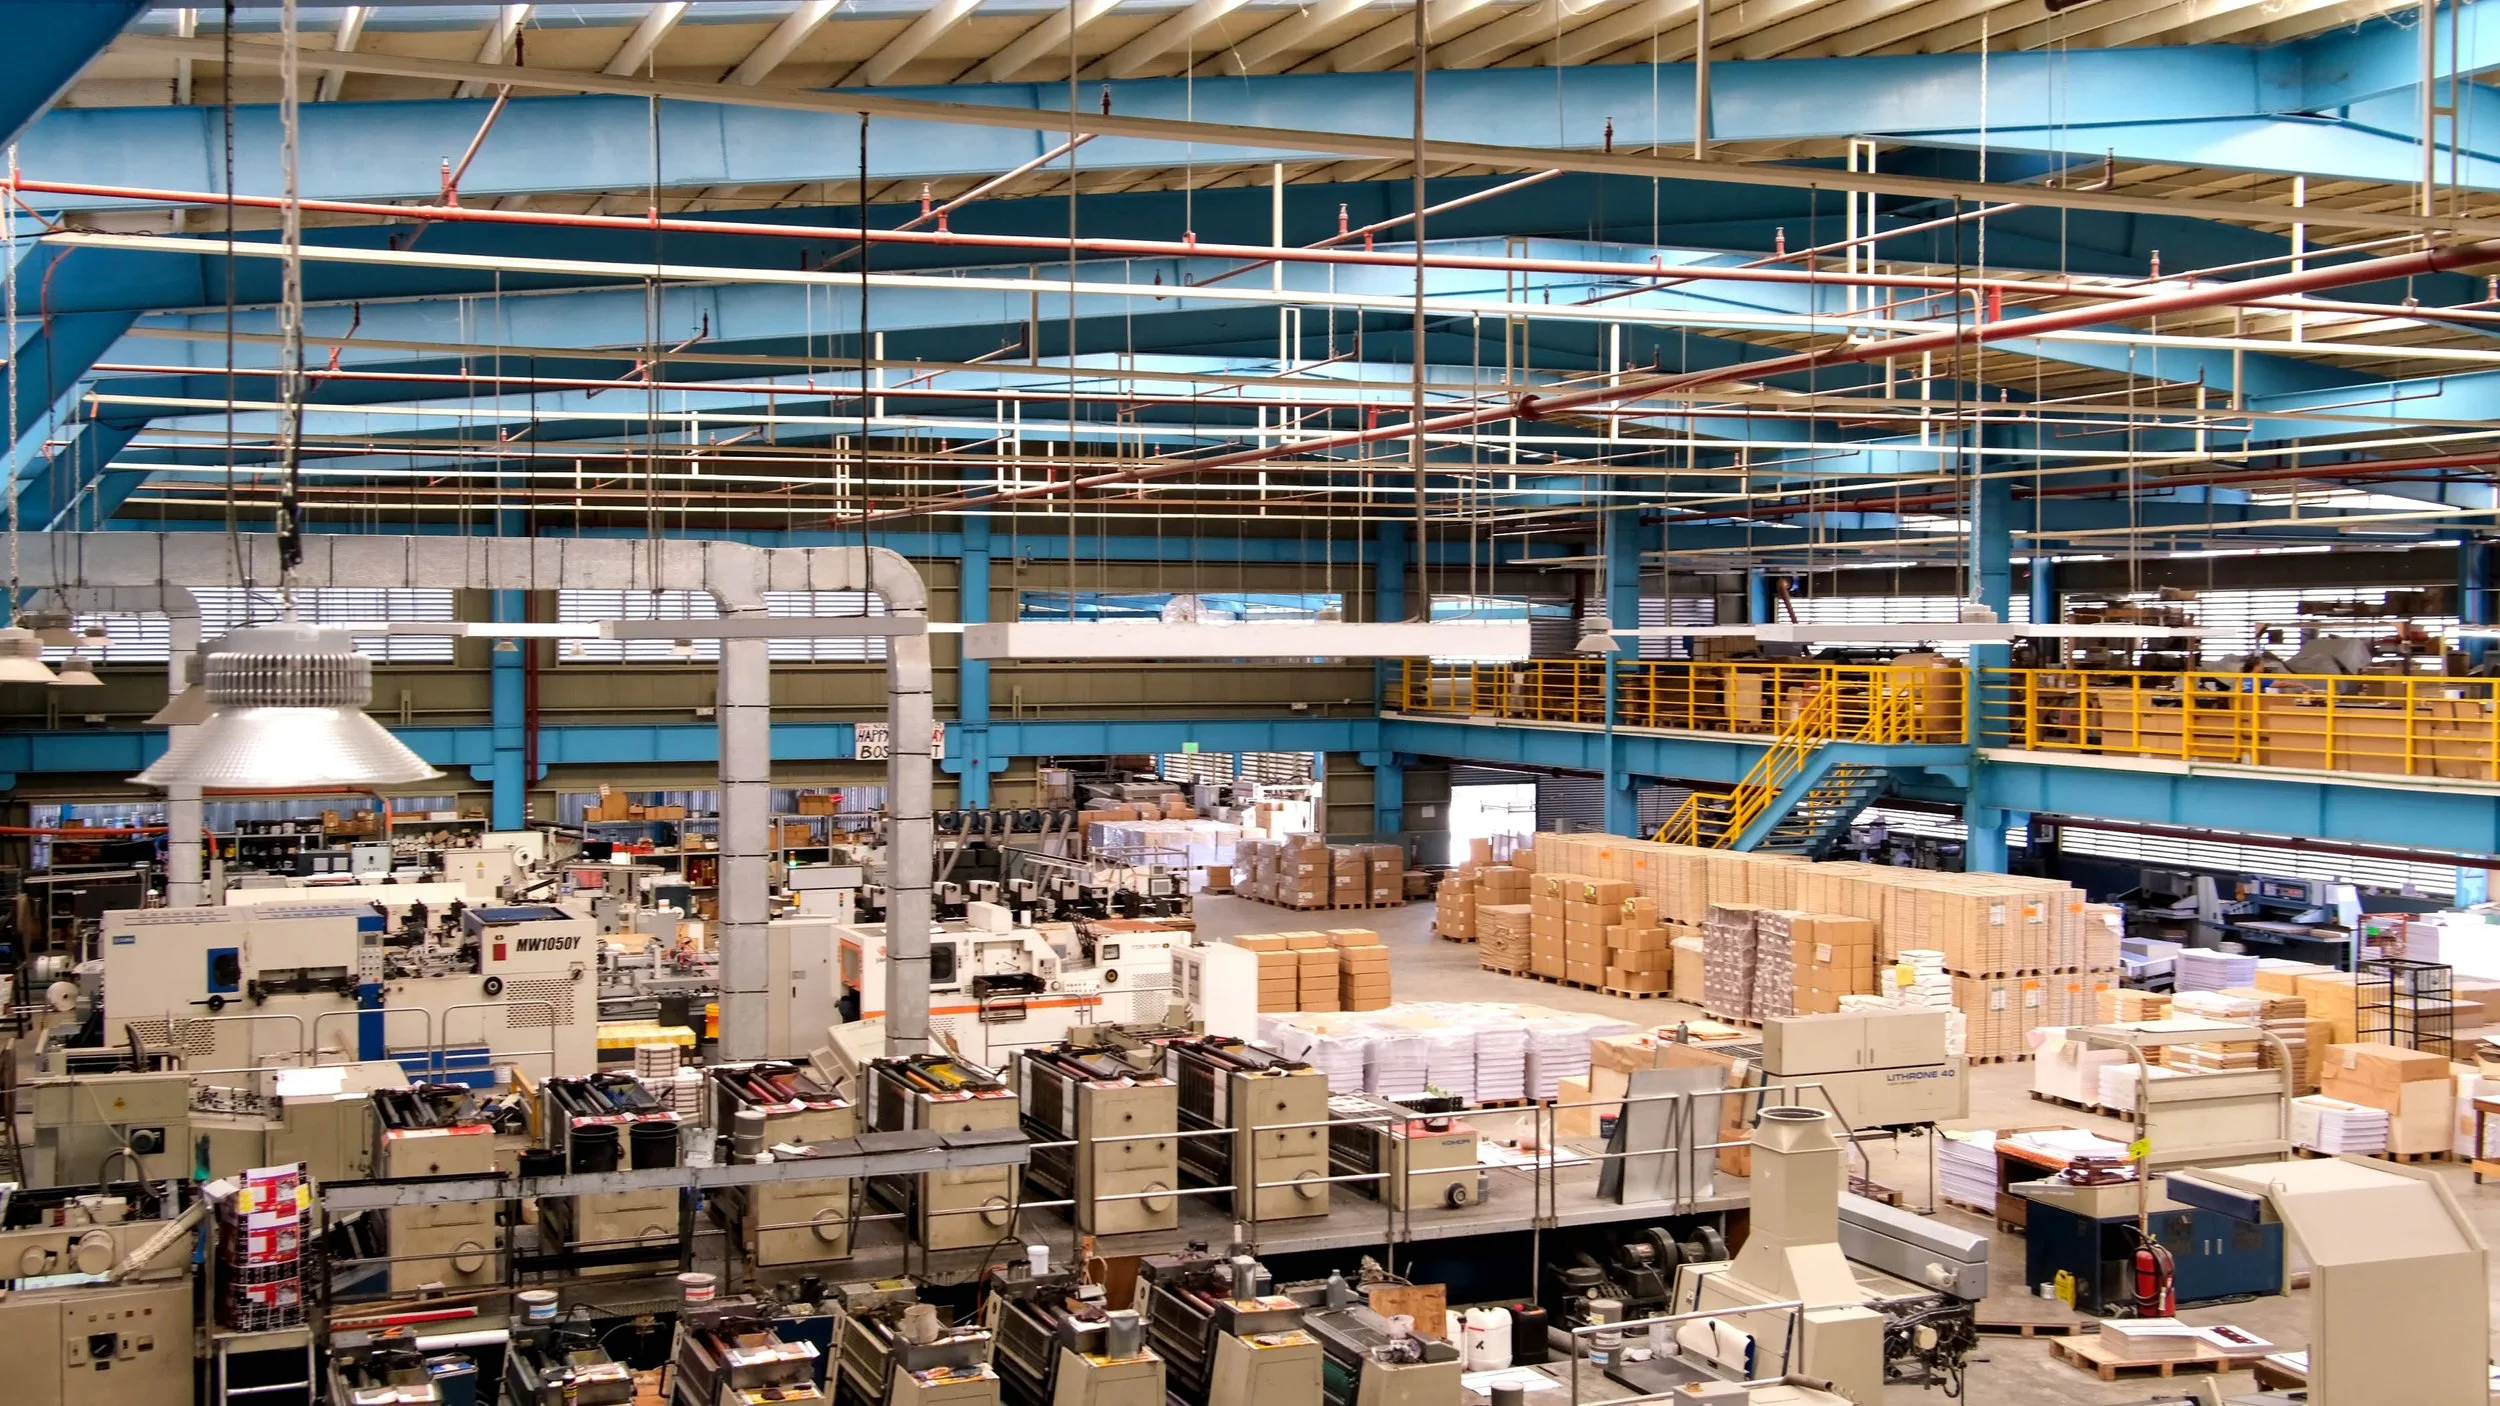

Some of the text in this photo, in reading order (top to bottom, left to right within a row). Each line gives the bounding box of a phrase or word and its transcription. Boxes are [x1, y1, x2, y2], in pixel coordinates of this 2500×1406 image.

[516, 936, 581, 952] MW1050Y
[1887, 1069, 1955, 1081] LITHRONE 40
